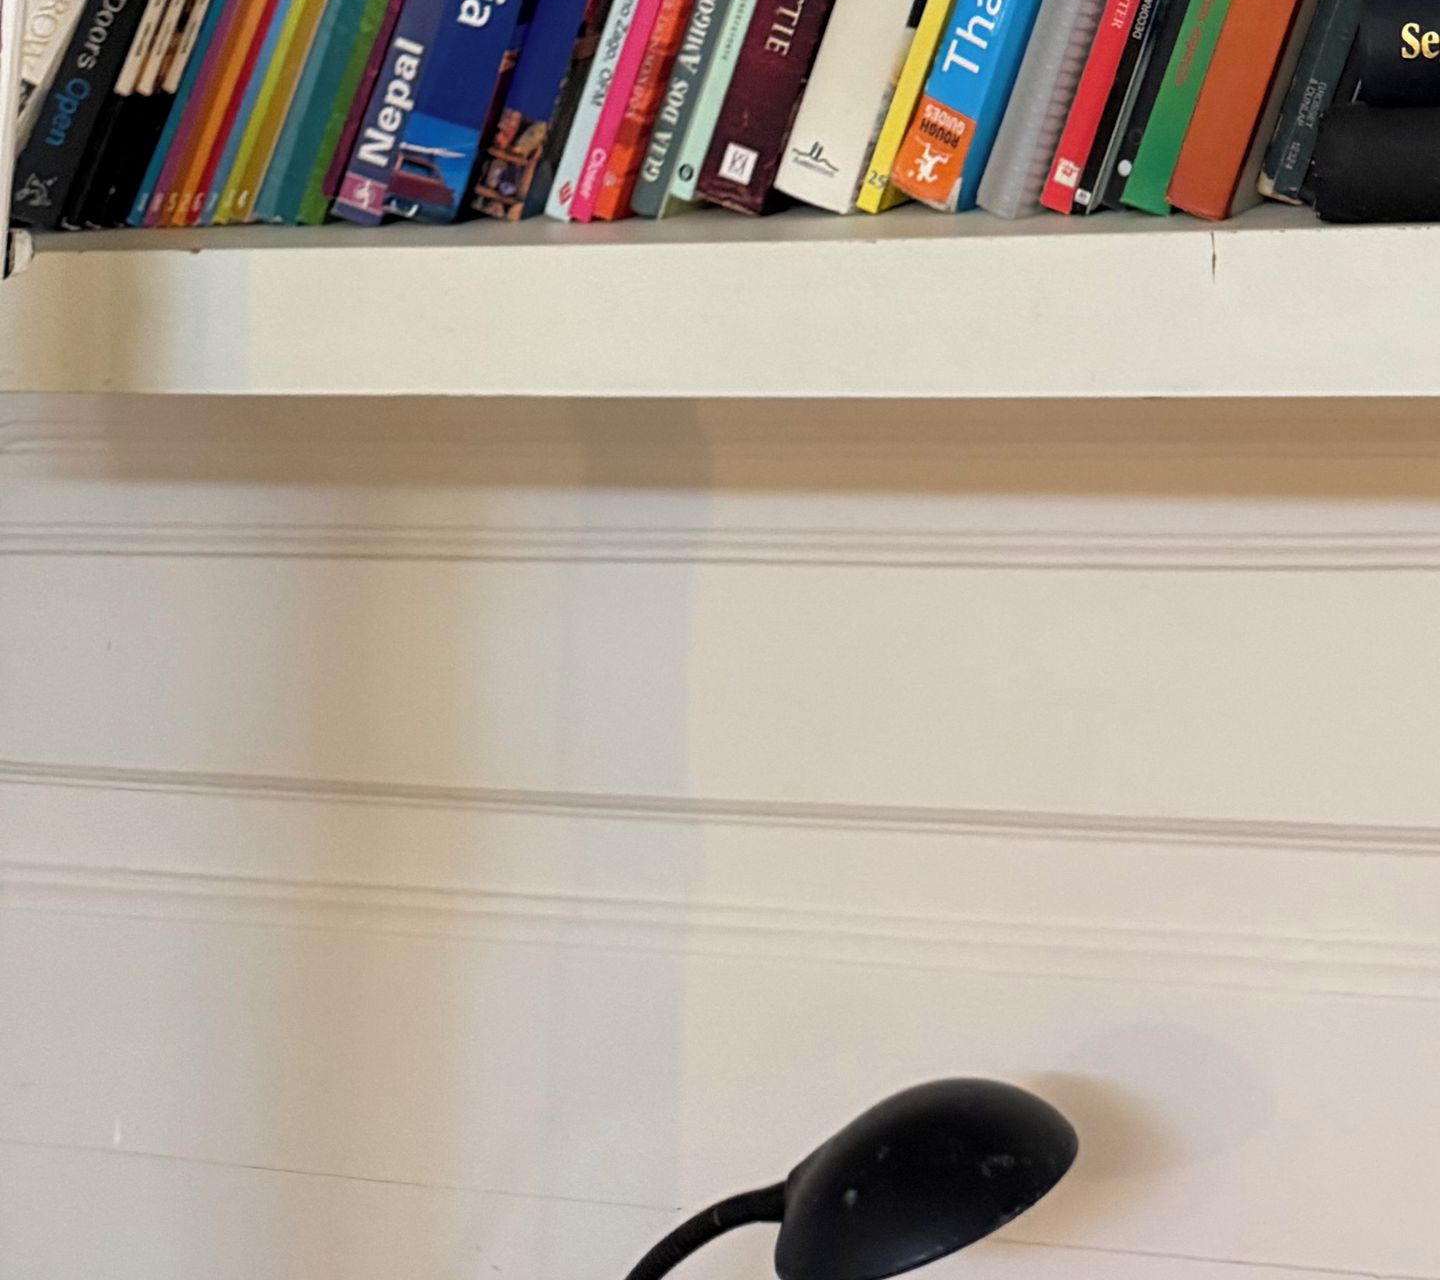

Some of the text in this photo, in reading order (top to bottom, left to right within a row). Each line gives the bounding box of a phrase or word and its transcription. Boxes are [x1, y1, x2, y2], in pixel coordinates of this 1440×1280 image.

[45, 78, 92, 146] Open
[357, 37, 424, 167] Nepal
[642, 129, 672, 183] GUIA
[662, 77, 689, 126] DOS
[920, 118, 961, 150] ROUGH
[924, 103, 966, 137] GUIDES
